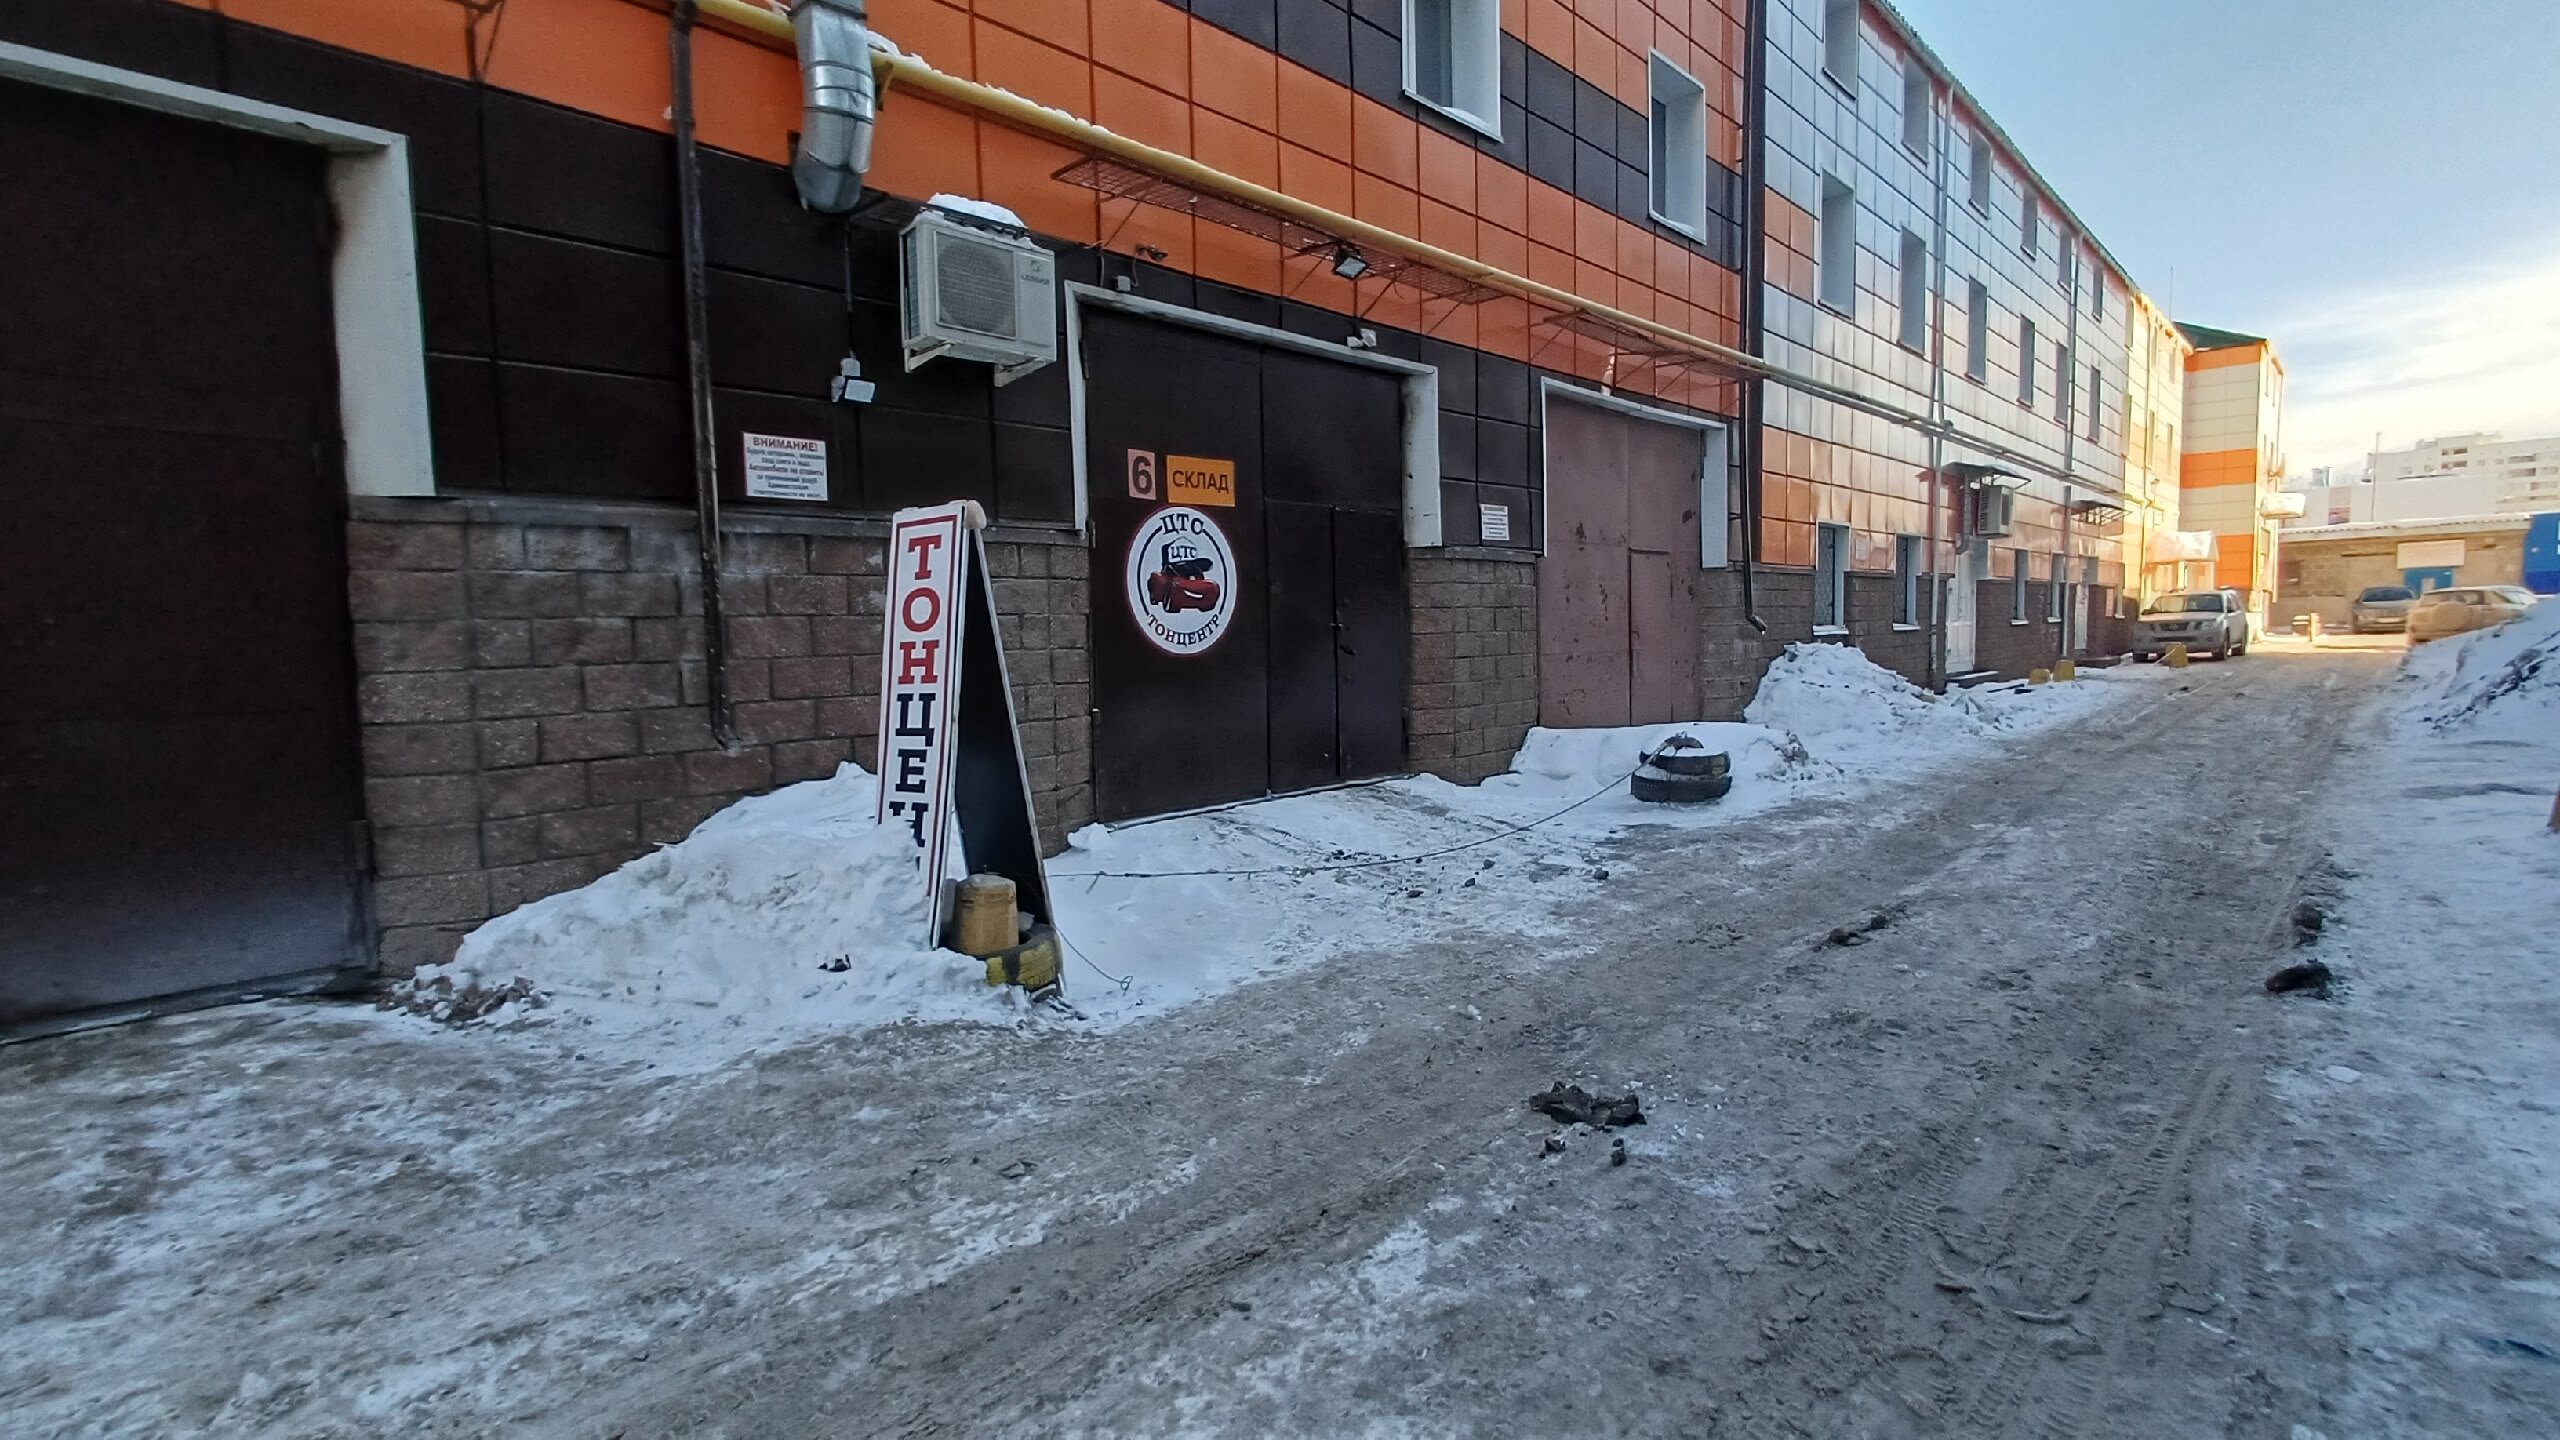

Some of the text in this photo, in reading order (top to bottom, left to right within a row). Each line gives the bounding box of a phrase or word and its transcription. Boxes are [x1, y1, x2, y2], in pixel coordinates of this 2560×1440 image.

[1132, 456, 1153, 495] 6
[1172, 470, 1229, 494] СКЛАД
[1160, 513, 1204, 535] ЦТС
[1171, 545, 1198, 560] ЦТС
[1148, 614, 1221, 648] ТОНЦЕНТР
[888, 534, 942, 872] ТОНЦЕН
